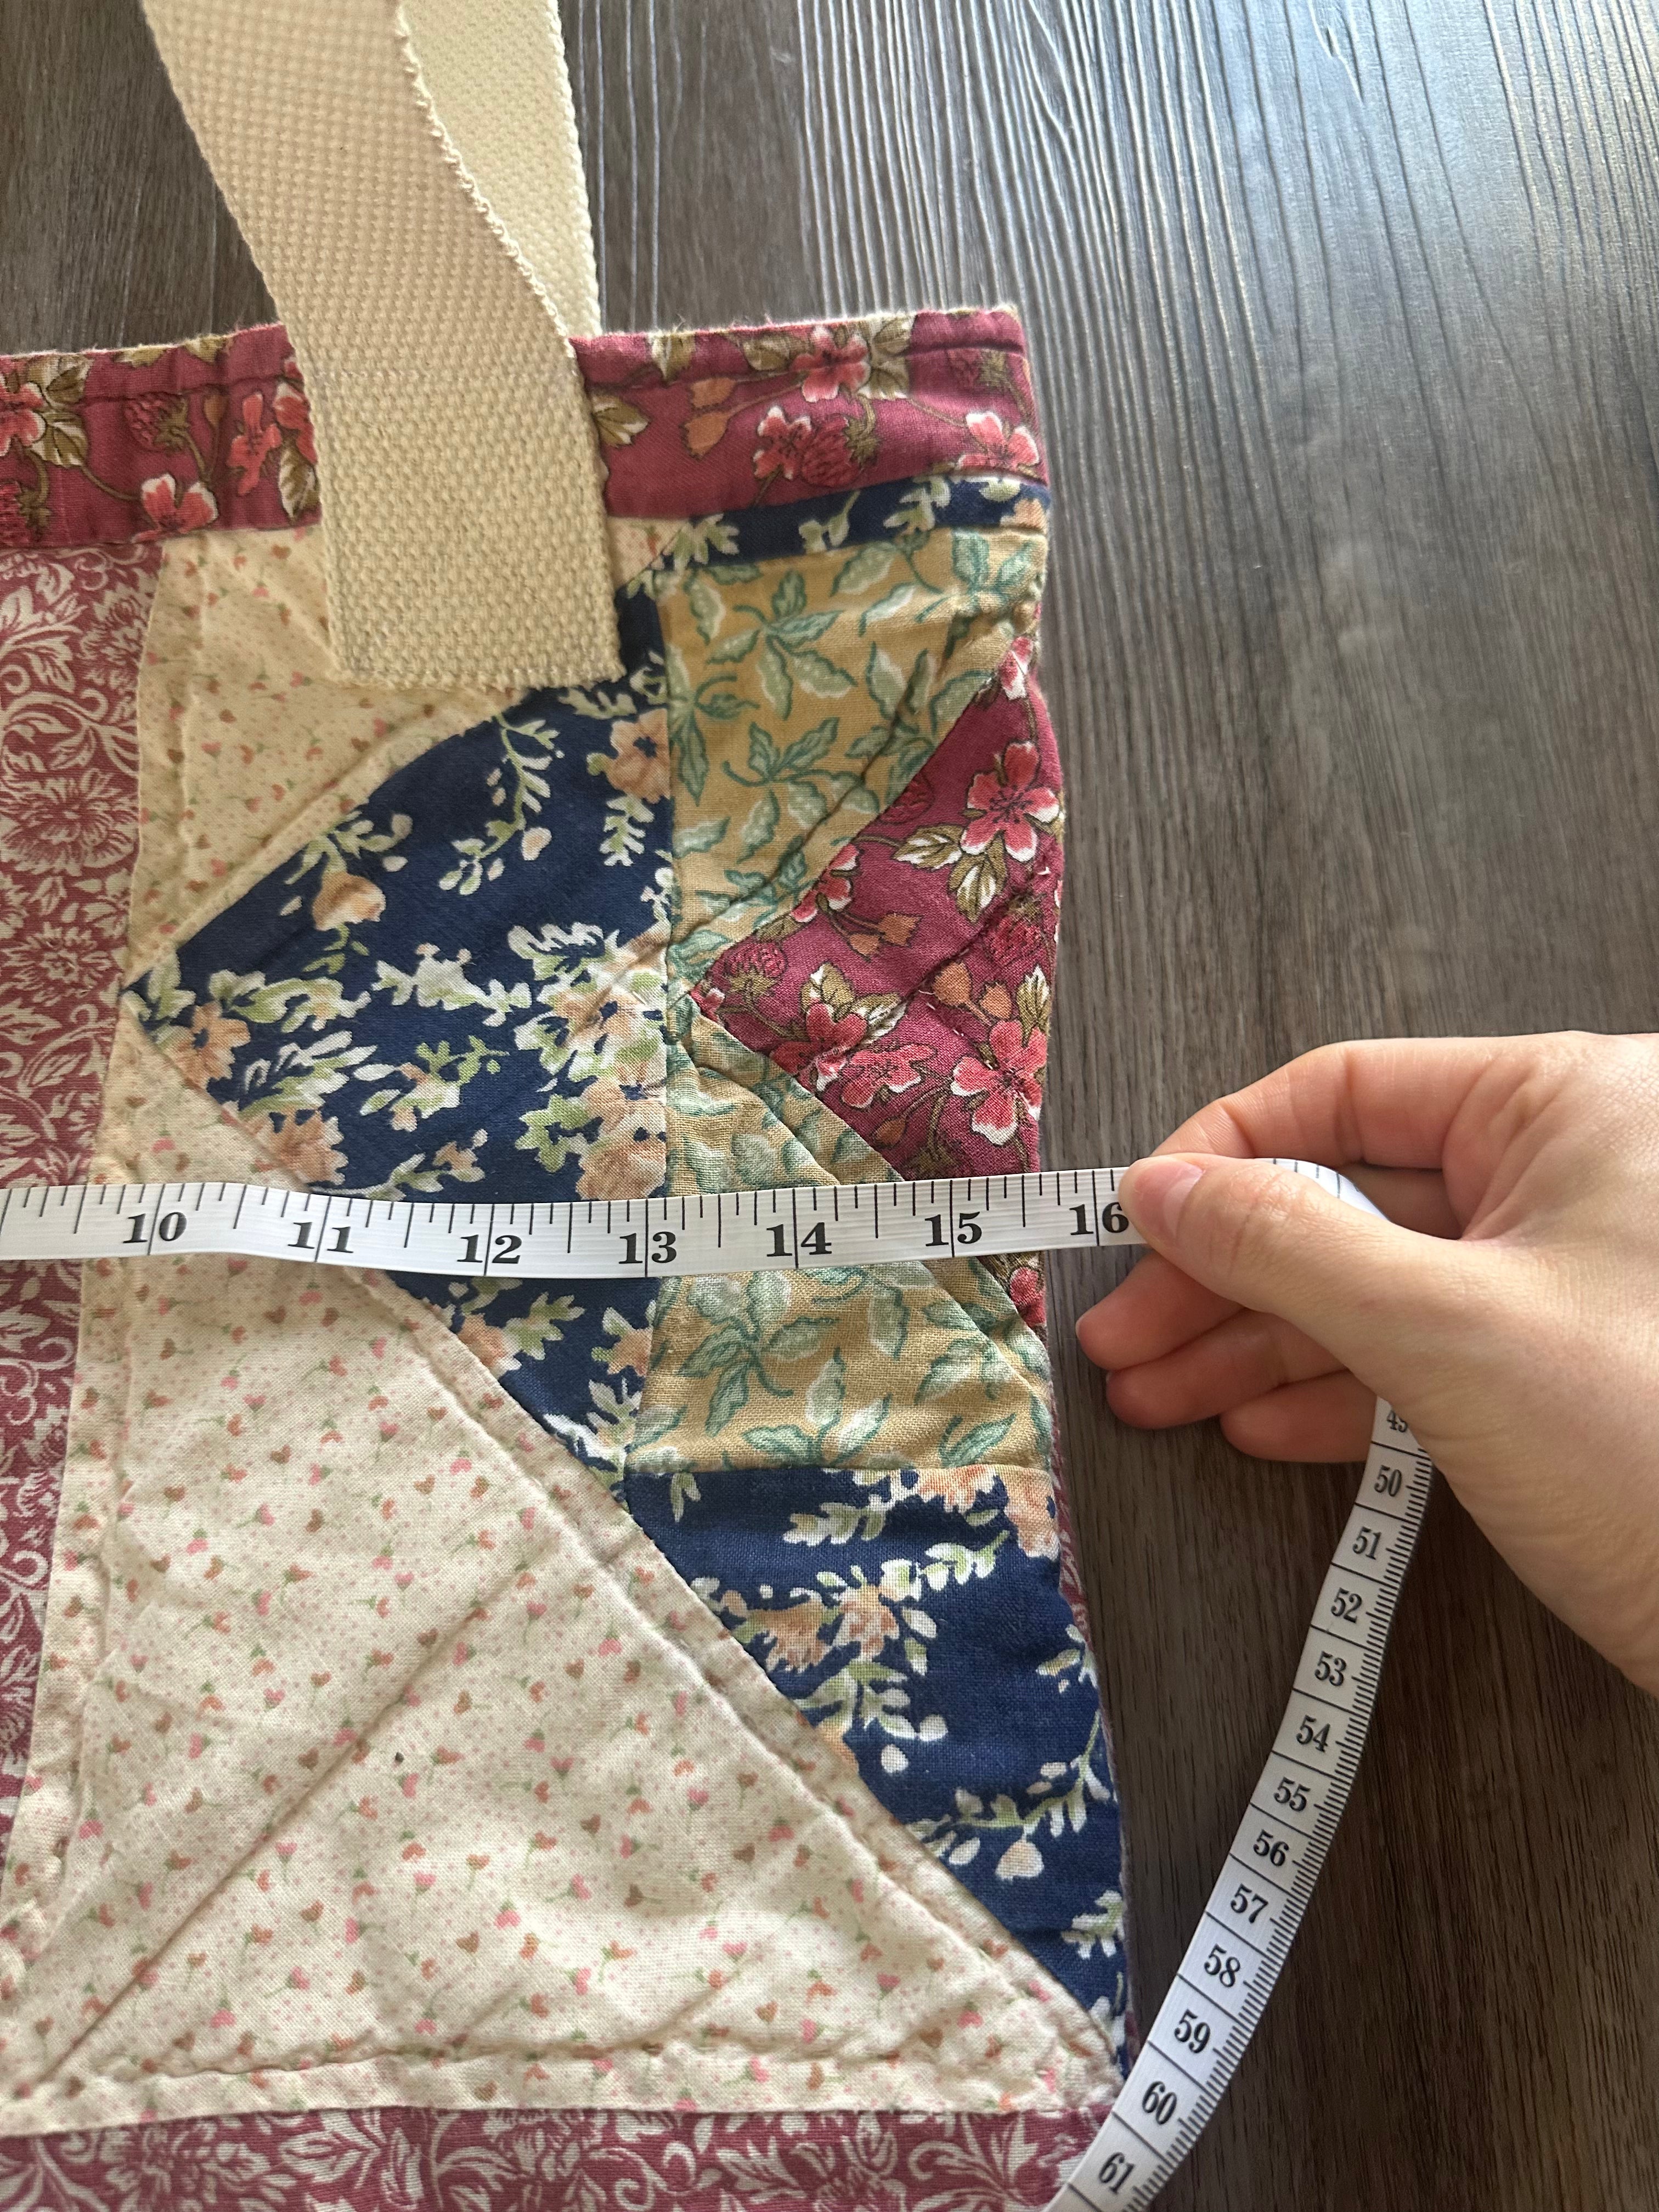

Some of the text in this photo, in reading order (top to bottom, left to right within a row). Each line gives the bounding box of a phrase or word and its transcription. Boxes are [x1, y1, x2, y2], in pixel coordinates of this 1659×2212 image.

[123, 1211, 187, 1243] 10
[926, 1212, 982, 1246] 15
[1069, 1201, 1129, 1235] 16
[289, 1222, 353, 1254] 11
[458, 1234, 522, 1264] 12
[619, 1231, 678, 1265] 13
[767, 1221, 832, 1257] 14
[1374, 1465, 1402, 1497] 50
[1352, 1527, 1382, 1560] 51
[1331, 1588, 1363, 1623] 52
[1314, 1651, 1347, 1686] 53
[1296, 1715, 1330, 1752] 54
[1274, 1777, 1310, 1812] 55
[1253, 1829, 1289, 1866] 56
[1231, 1883, 1268, 1923] 57
[1204, 1944, 1240, 1988] 58
[1175, 2010, 1210, 2053] 59
[1142, 2081, 1177, 2125] 60
[1099, 2152, 1135, 2193] 61
